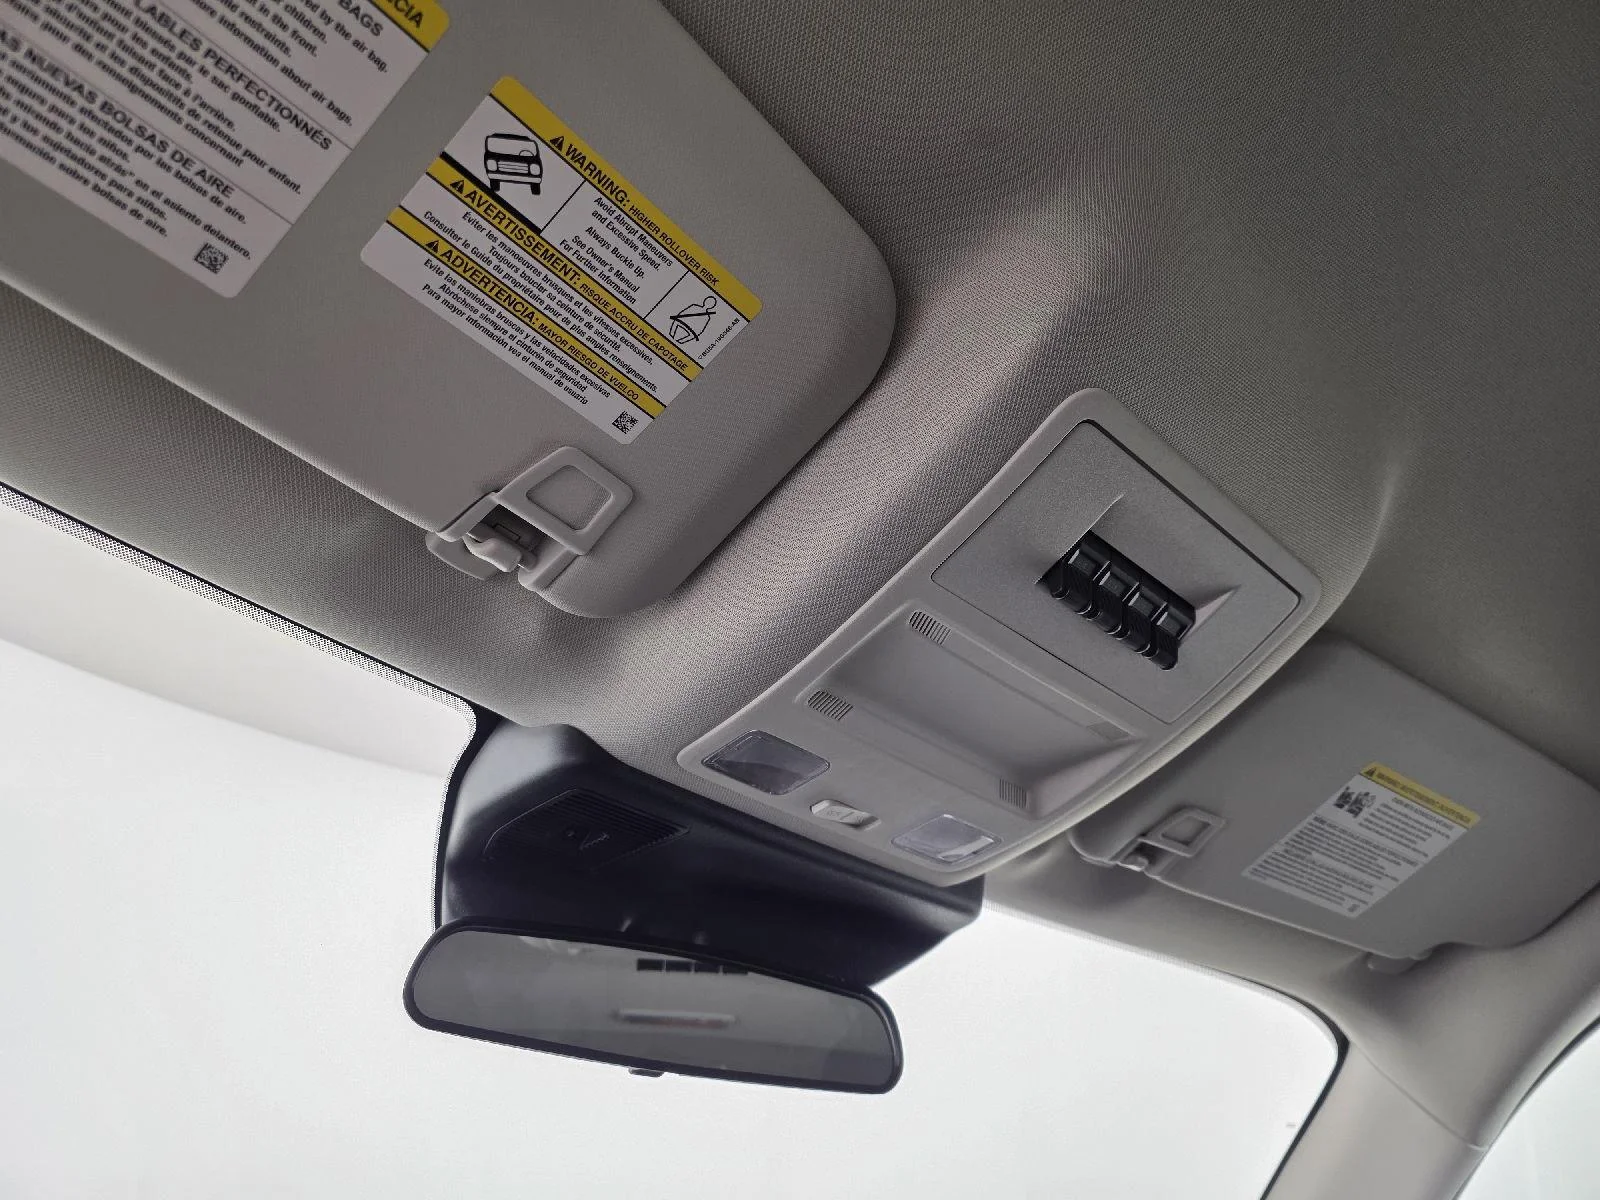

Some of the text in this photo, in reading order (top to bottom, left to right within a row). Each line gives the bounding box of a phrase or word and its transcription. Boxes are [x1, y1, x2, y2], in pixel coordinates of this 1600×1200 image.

[290, 29, 317, 57] front.
[319, 9, 334, 26] by
[334, 22, 352, 40] the
[352, 39, 368, 53] air
[367, 50, 387, 73] bag.
[203, 48, 332, 150] PERFECTIONNÉS
[280, 65, 312, 92] about
[311, 90, 327, 103] air
[326, 100, 352, 126] bags.
[170, 149, 196, 171] DE
[194, 168, 234, 198] AIRE
[241, 148, 268, 168] pour
[268, 167, 301, 195] enfant.
[203, 224, 250, 260] delantero.
[209, 195, 224, 207] de
[224, 205, 246, 224] aire.
[565, 143, 720, 286] WARNING: HIGHER ROLLOVER RISK
[591, 209, 661, 271] and Excessive Speed.
[593, 196, 673, 267] Avoid Abrupt Maneuvers
[423, 210, 463, 242] Consulter
[461, 239, 471, 250] le
[470, 246, 493, 266] Guide
[492, 264, 504, 275] du
[501, 272, 545, 306] propriétaire
[543, 303, 563, 318] pour
[561, 316, 572, 326] de
[569, 323, 587, 338] plus
[585, 335, 610, 355] amples
[463, 189, 689, 372] AVERTISSEMENT: RISQUE ACCRU DE CAPOTAGE
[559, 238, 636, 304] For Further Information
[571, 235, 640, 293] See Owner's Manual
[585, 226, 645, 279] Always Buckle Up.
[461, 211, 653, 365] Éviter les manoeuvres brusques et les vitesses excessives.
[488, 245, 621, 353] Toujours boucler sa ceinture de sécurité.
[422, 283, 588, 405] Para mayor información vea el manual de usuario
[423, 258, 611, 398] Evite las maniobras bruscas y las velocidades excesivas
[438, 283, 588, 393] Abróchese siempre el cinturón de seguridad
[439, 249, 639, 401] ADVERTENCIA: MAYOR RIESGO DE VUELCO
